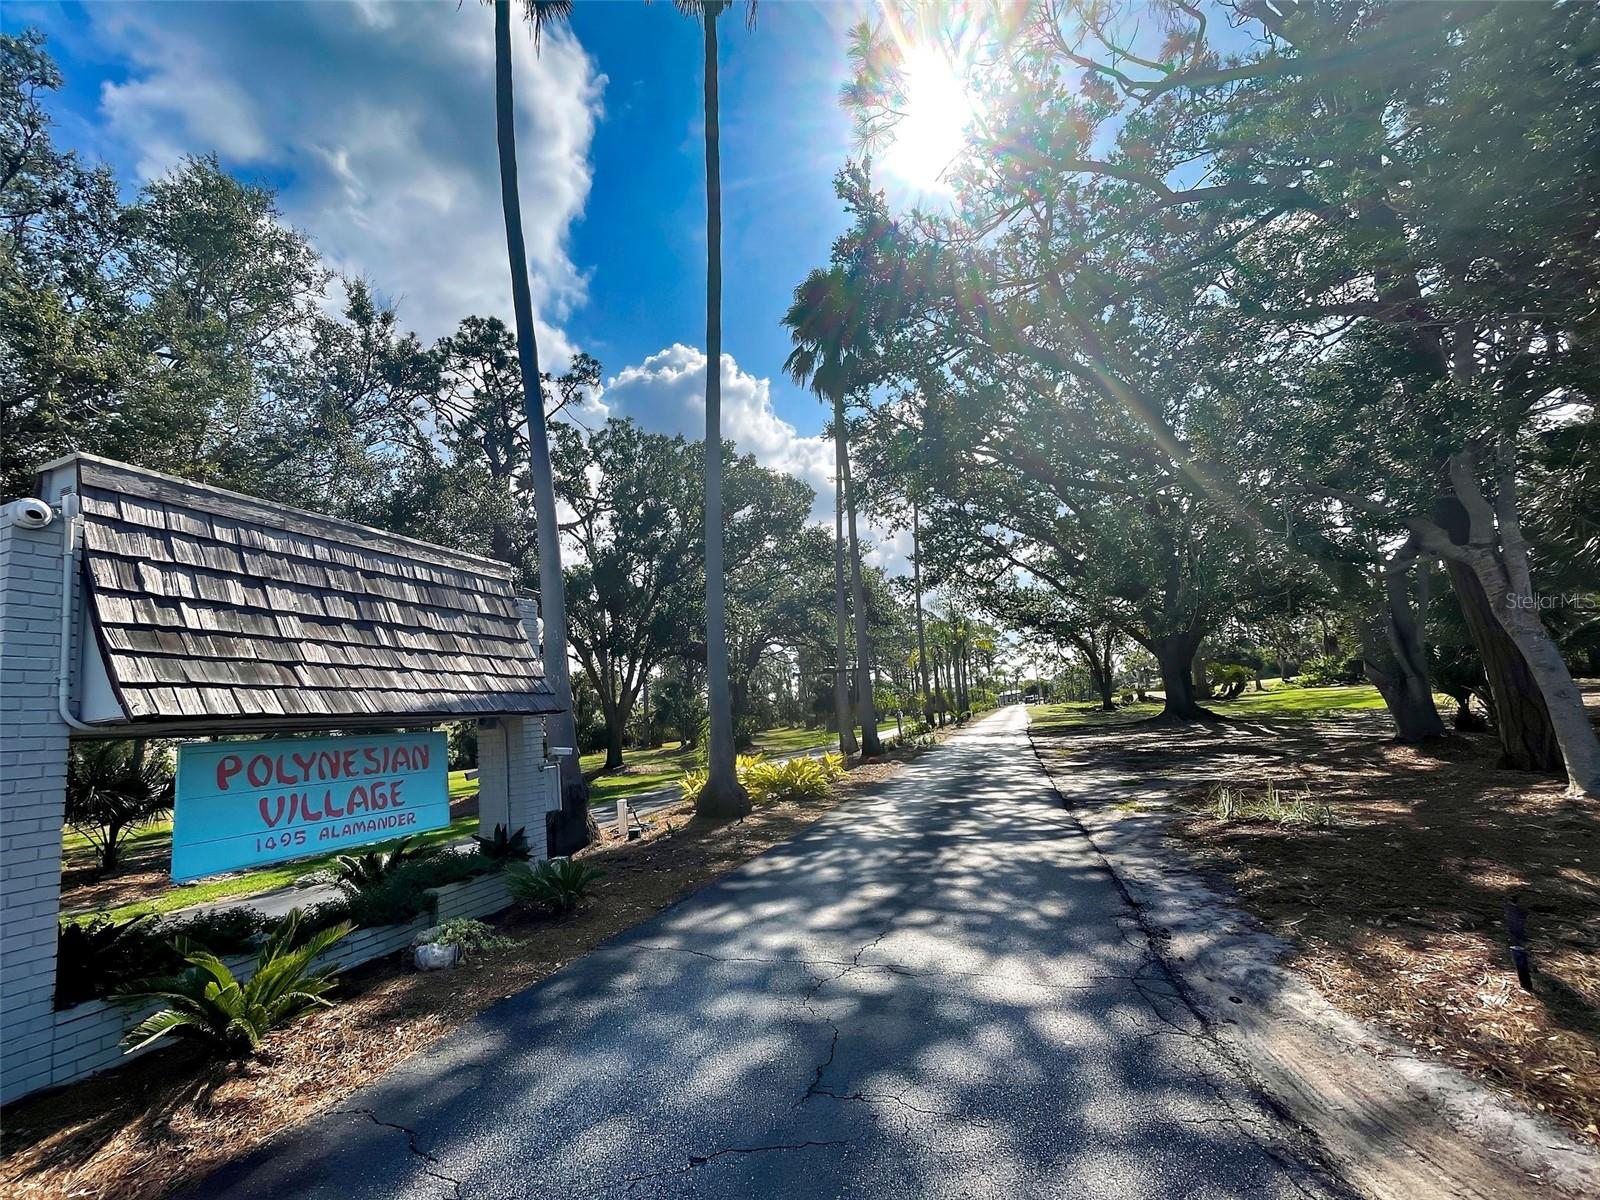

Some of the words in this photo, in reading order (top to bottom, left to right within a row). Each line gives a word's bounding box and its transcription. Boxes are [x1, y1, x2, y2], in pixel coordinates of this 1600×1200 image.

[216, 744, 430, 791] POLYNESIAN
[259, 780, 405, 828] VILLAGE
[256, 830, 306, 852] 1495
[319, 812, 416, 841] ALAMANDER
